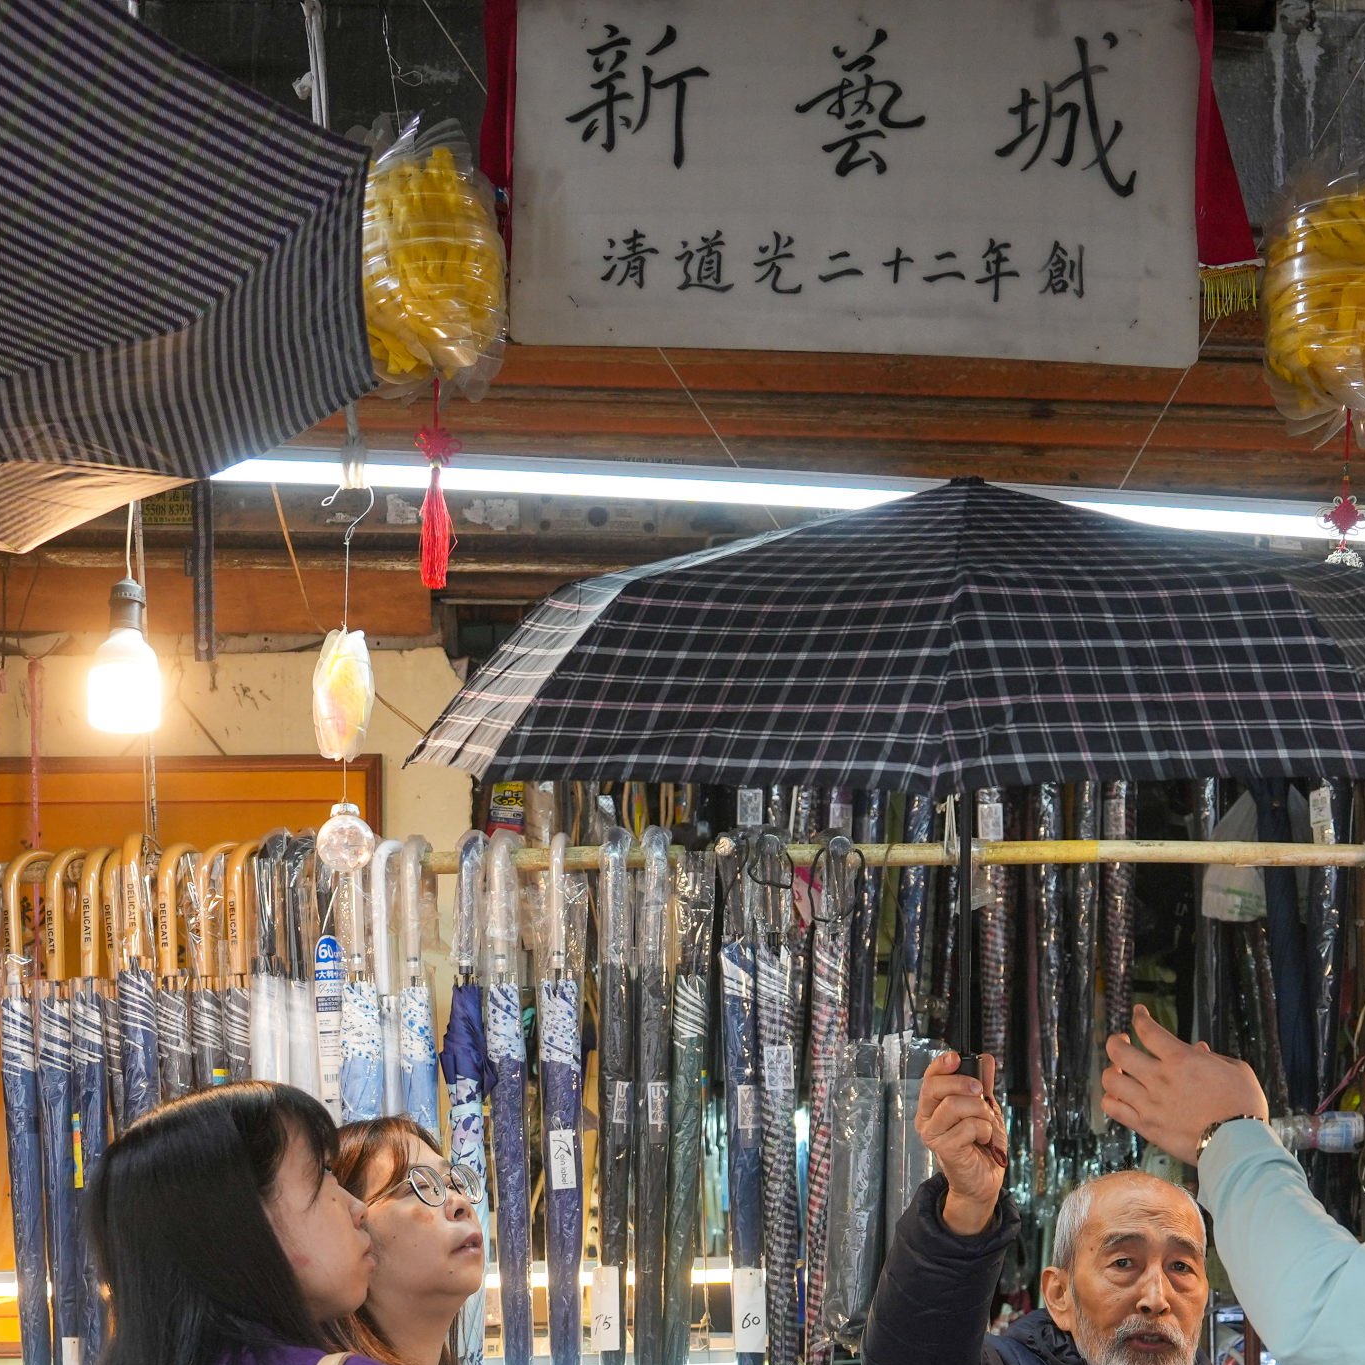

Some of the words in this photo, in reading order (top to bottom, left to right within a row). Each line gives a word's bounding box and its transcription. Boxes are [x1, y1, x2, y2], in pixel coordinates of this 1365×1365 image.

[566, 25, 1136, 198] 新藝城
[600, 229, 1086, 302] 清道光二十二年創
[82, 897, 92, 943] DELICATE
[104, 904, 114, 949] DELICATE
[126, 882, 137, 928] DELICATE
[159, 903, 169, 948] DELICATE
[228, 900, 237, 946] DELICATE
[46, 909, 55, 955] DELICATE
[741, 1313, 761, 1330] 60
